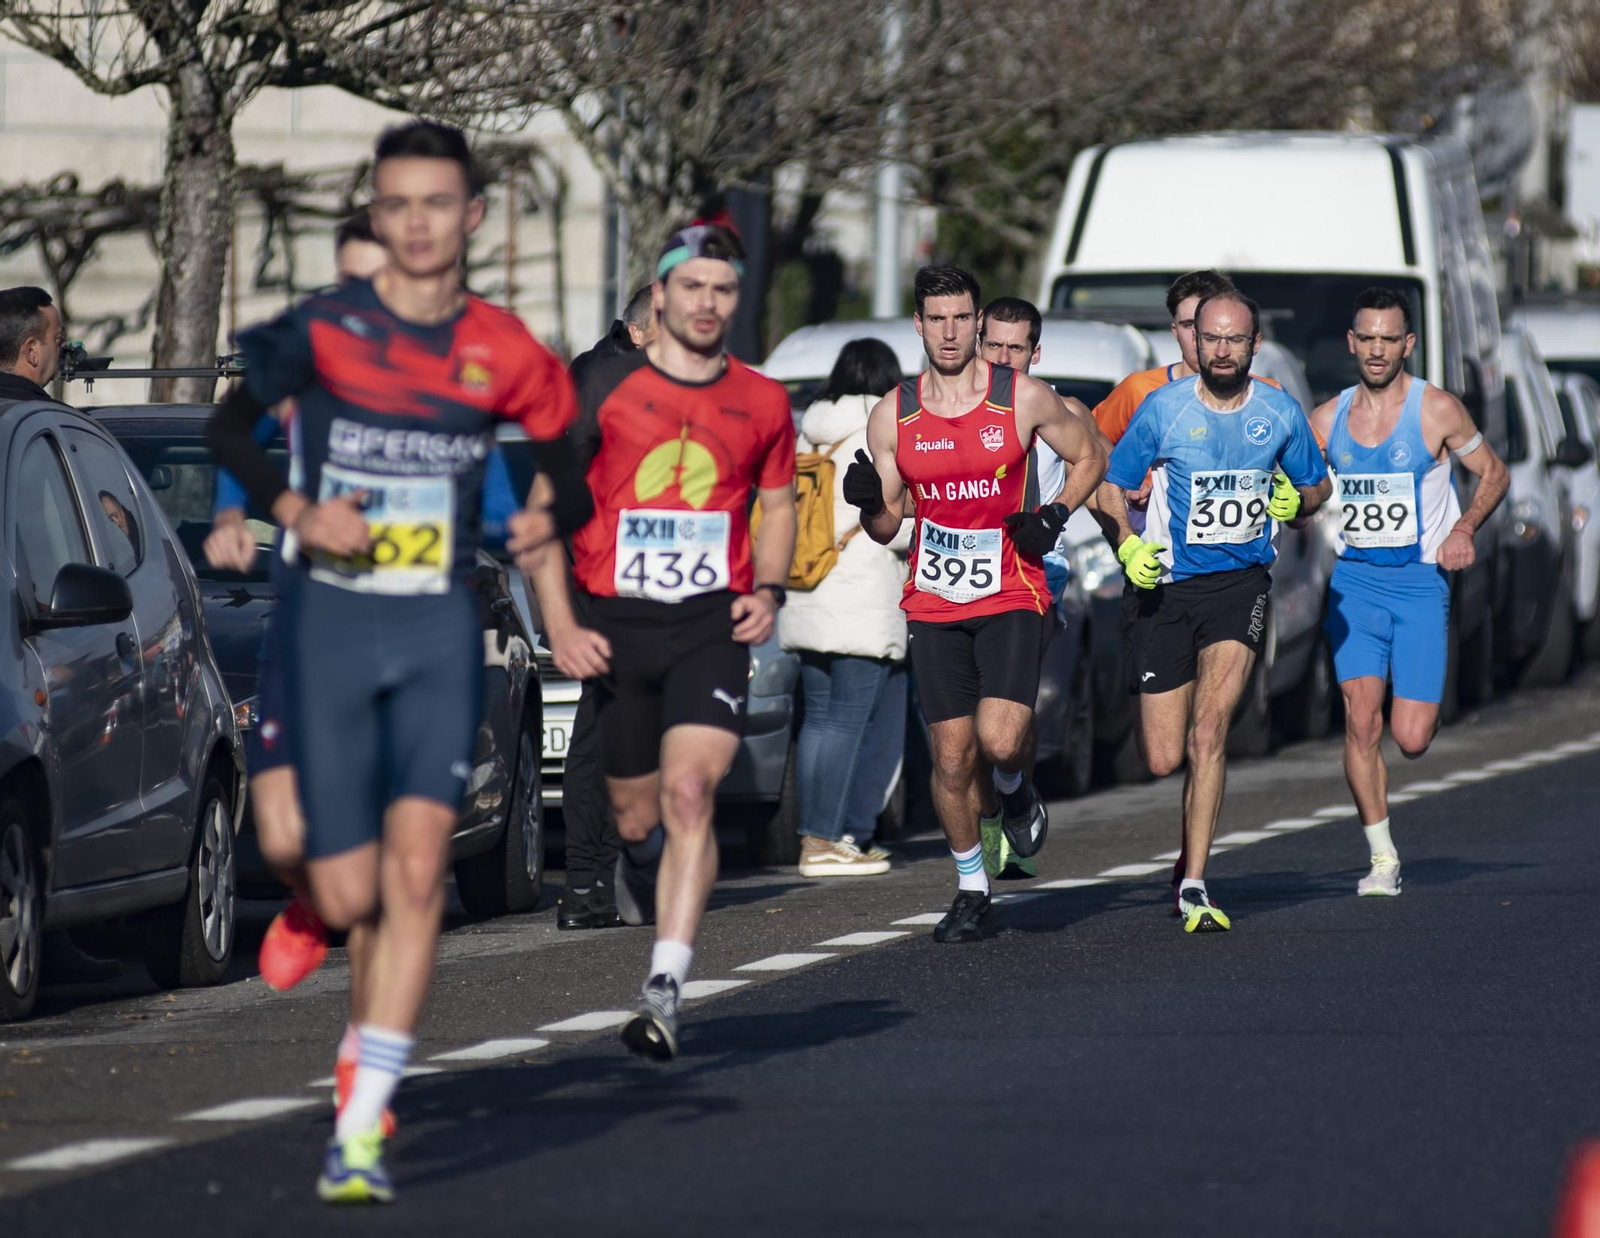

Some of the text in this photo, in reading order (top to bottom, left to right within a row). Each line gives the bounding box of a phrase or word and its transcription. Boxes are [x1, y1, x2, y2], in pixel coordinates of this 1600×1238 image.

[915, 438, 954, 453] aqualia
[919, 483, 940, 500] LA
[945, 478, 1001, 500] GANGA
[1196, 475, 1237, 491] XXII
[1341, 479, 1375, 495] XXII
[1191, 498, 1265, 527] 309
[1342, 503, 1409, 532] 289
[625, 518, 675, 539] XXII
[925, 524, 960, 550] XXII
[369, 524, 440, 566] 62
[621, 552, 718, 589] 436
[921, 548, 993, 589] 395
[1247, 594, 1267, 643] Joma
